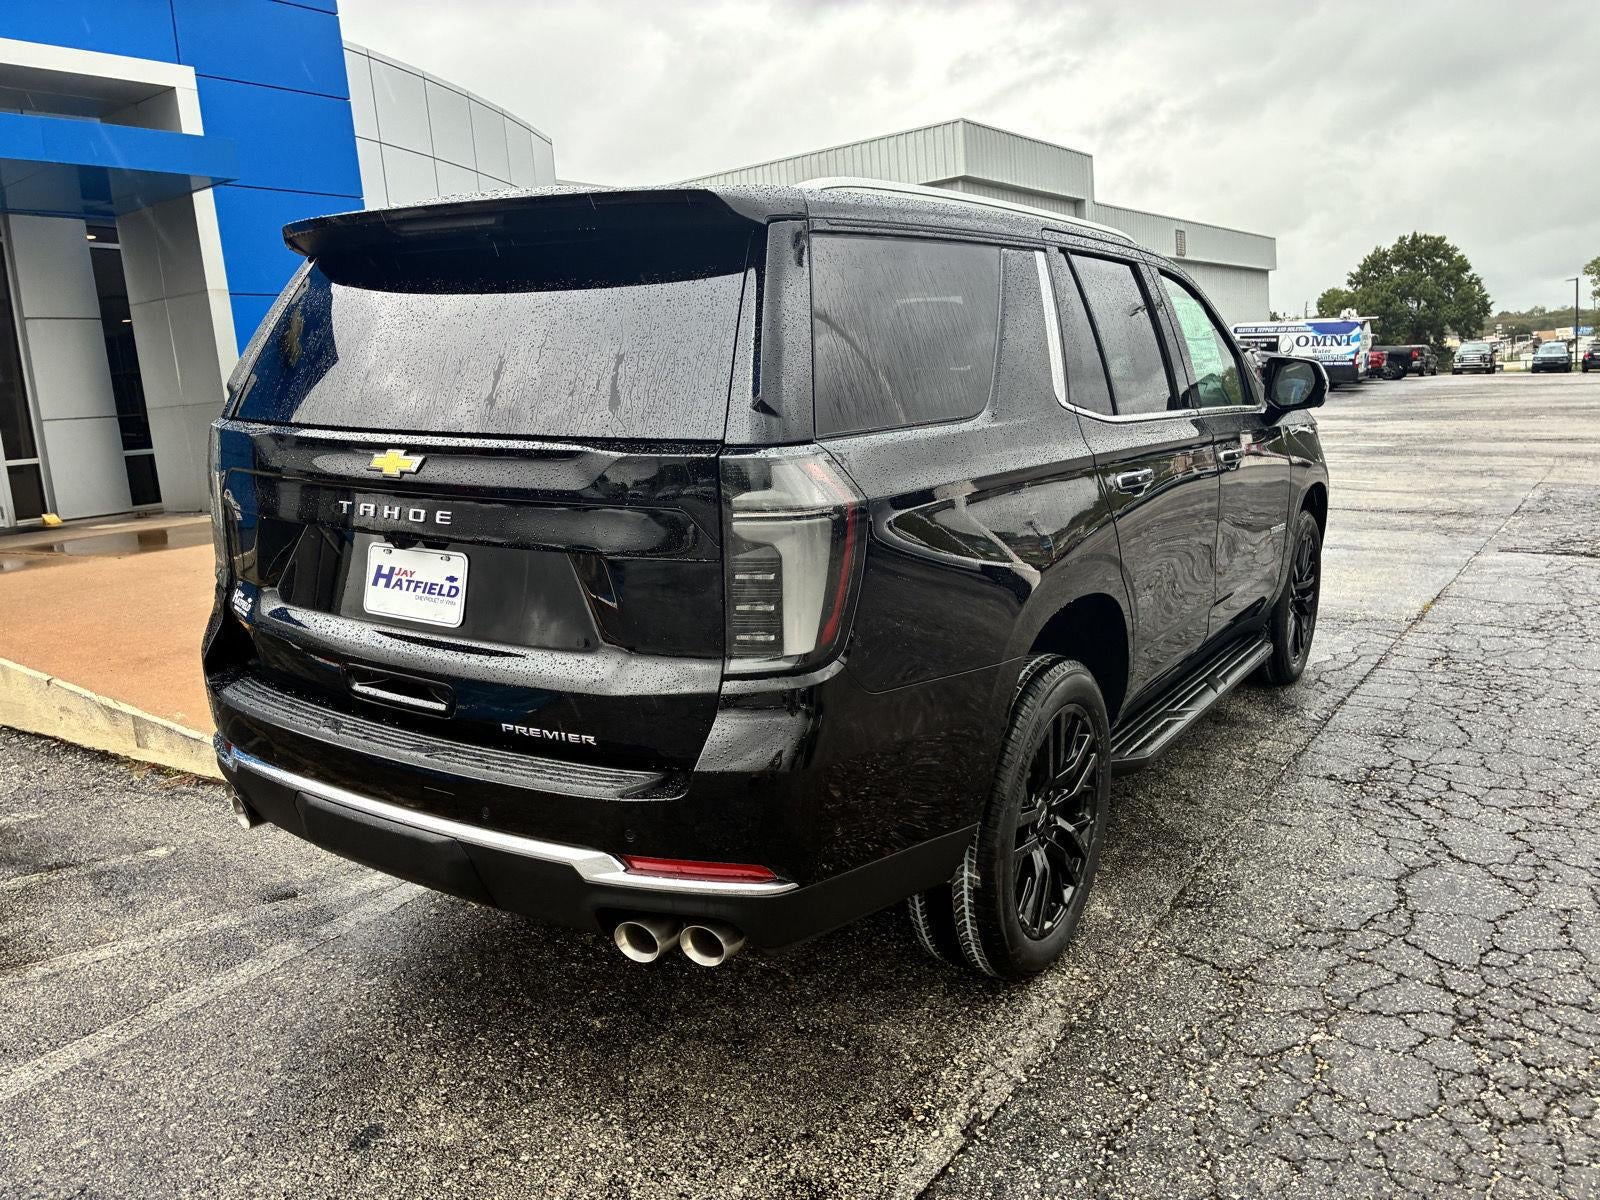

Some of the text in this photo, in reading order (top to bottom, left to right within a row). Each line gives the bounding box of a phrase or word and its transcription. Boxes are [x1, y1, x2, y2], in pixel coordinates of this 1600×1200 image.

[1295, 334, 1352, 347] OMNI
[338, 500, 452, 525] TAHOE
[372, 564, 460, 598] HATFIELD
[394, 568, 416, 578] JAY
[415, 595, 440, 603] CHEVROLET
[501, 723, 597, 746] PREMIER
